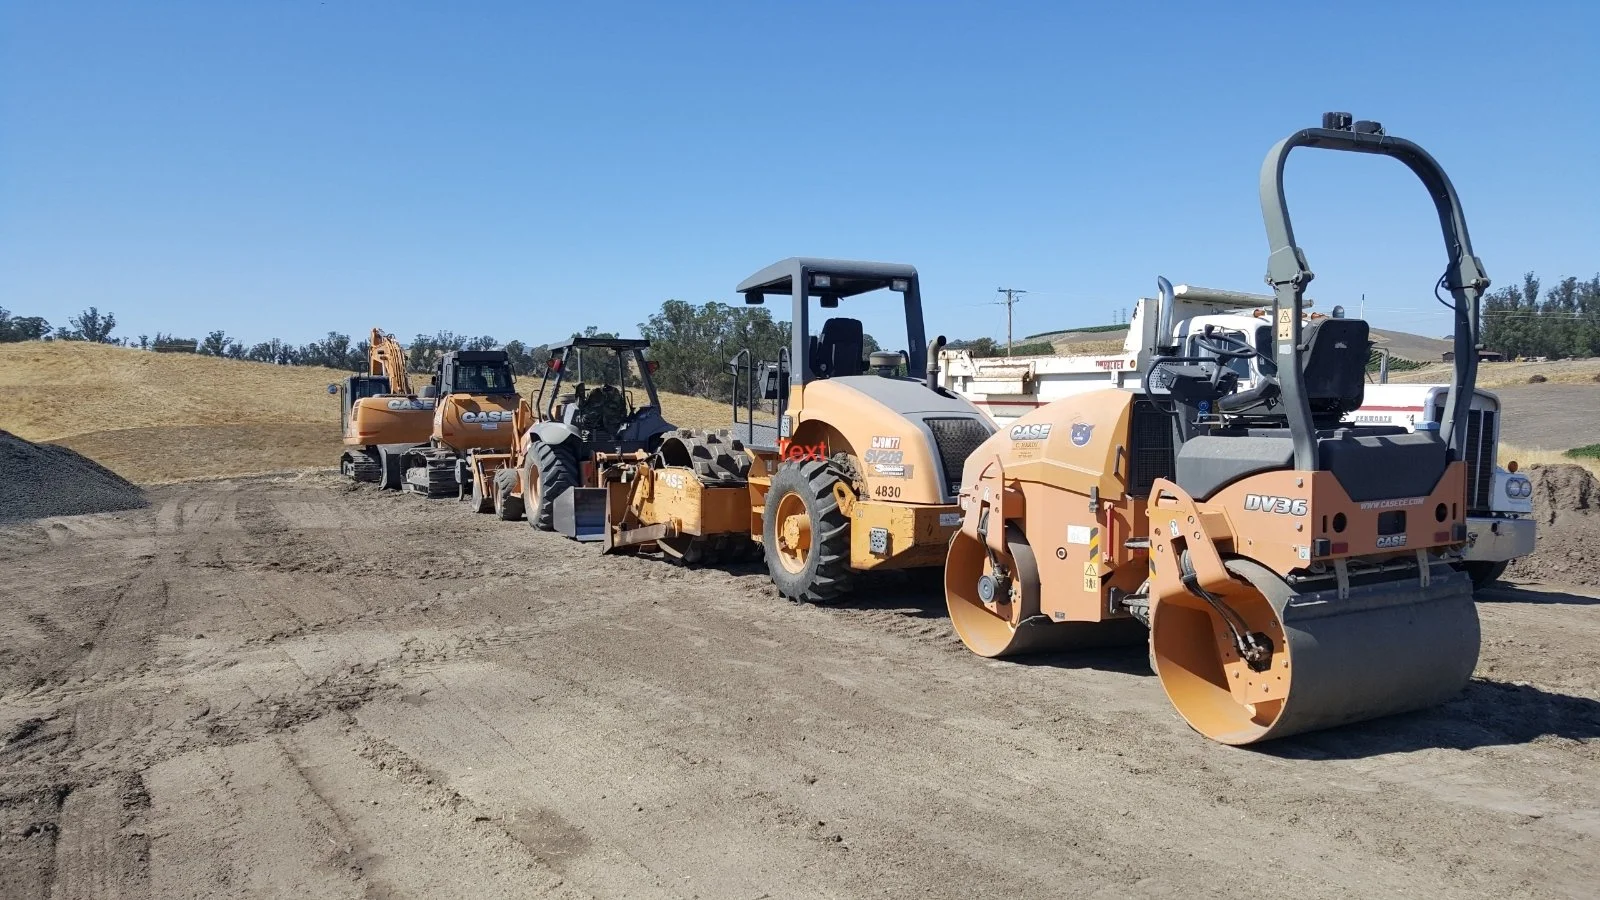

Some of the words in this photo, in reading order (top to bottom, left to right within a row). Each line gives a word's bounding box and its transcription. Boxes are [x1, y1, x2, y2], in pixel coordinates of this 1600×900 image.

[388, 399, 434, 410] CASE
[461, 410, 513, 423] CASE
[1010, 424, 1052, 440] CASE
[875, 485, 901, 498] 4830
[1244, 494, 1308, 516] DV36
[1360, 497, 1424, 510] WWW.CASECE.COM
[1376, 535, 1407, 548] CASE
